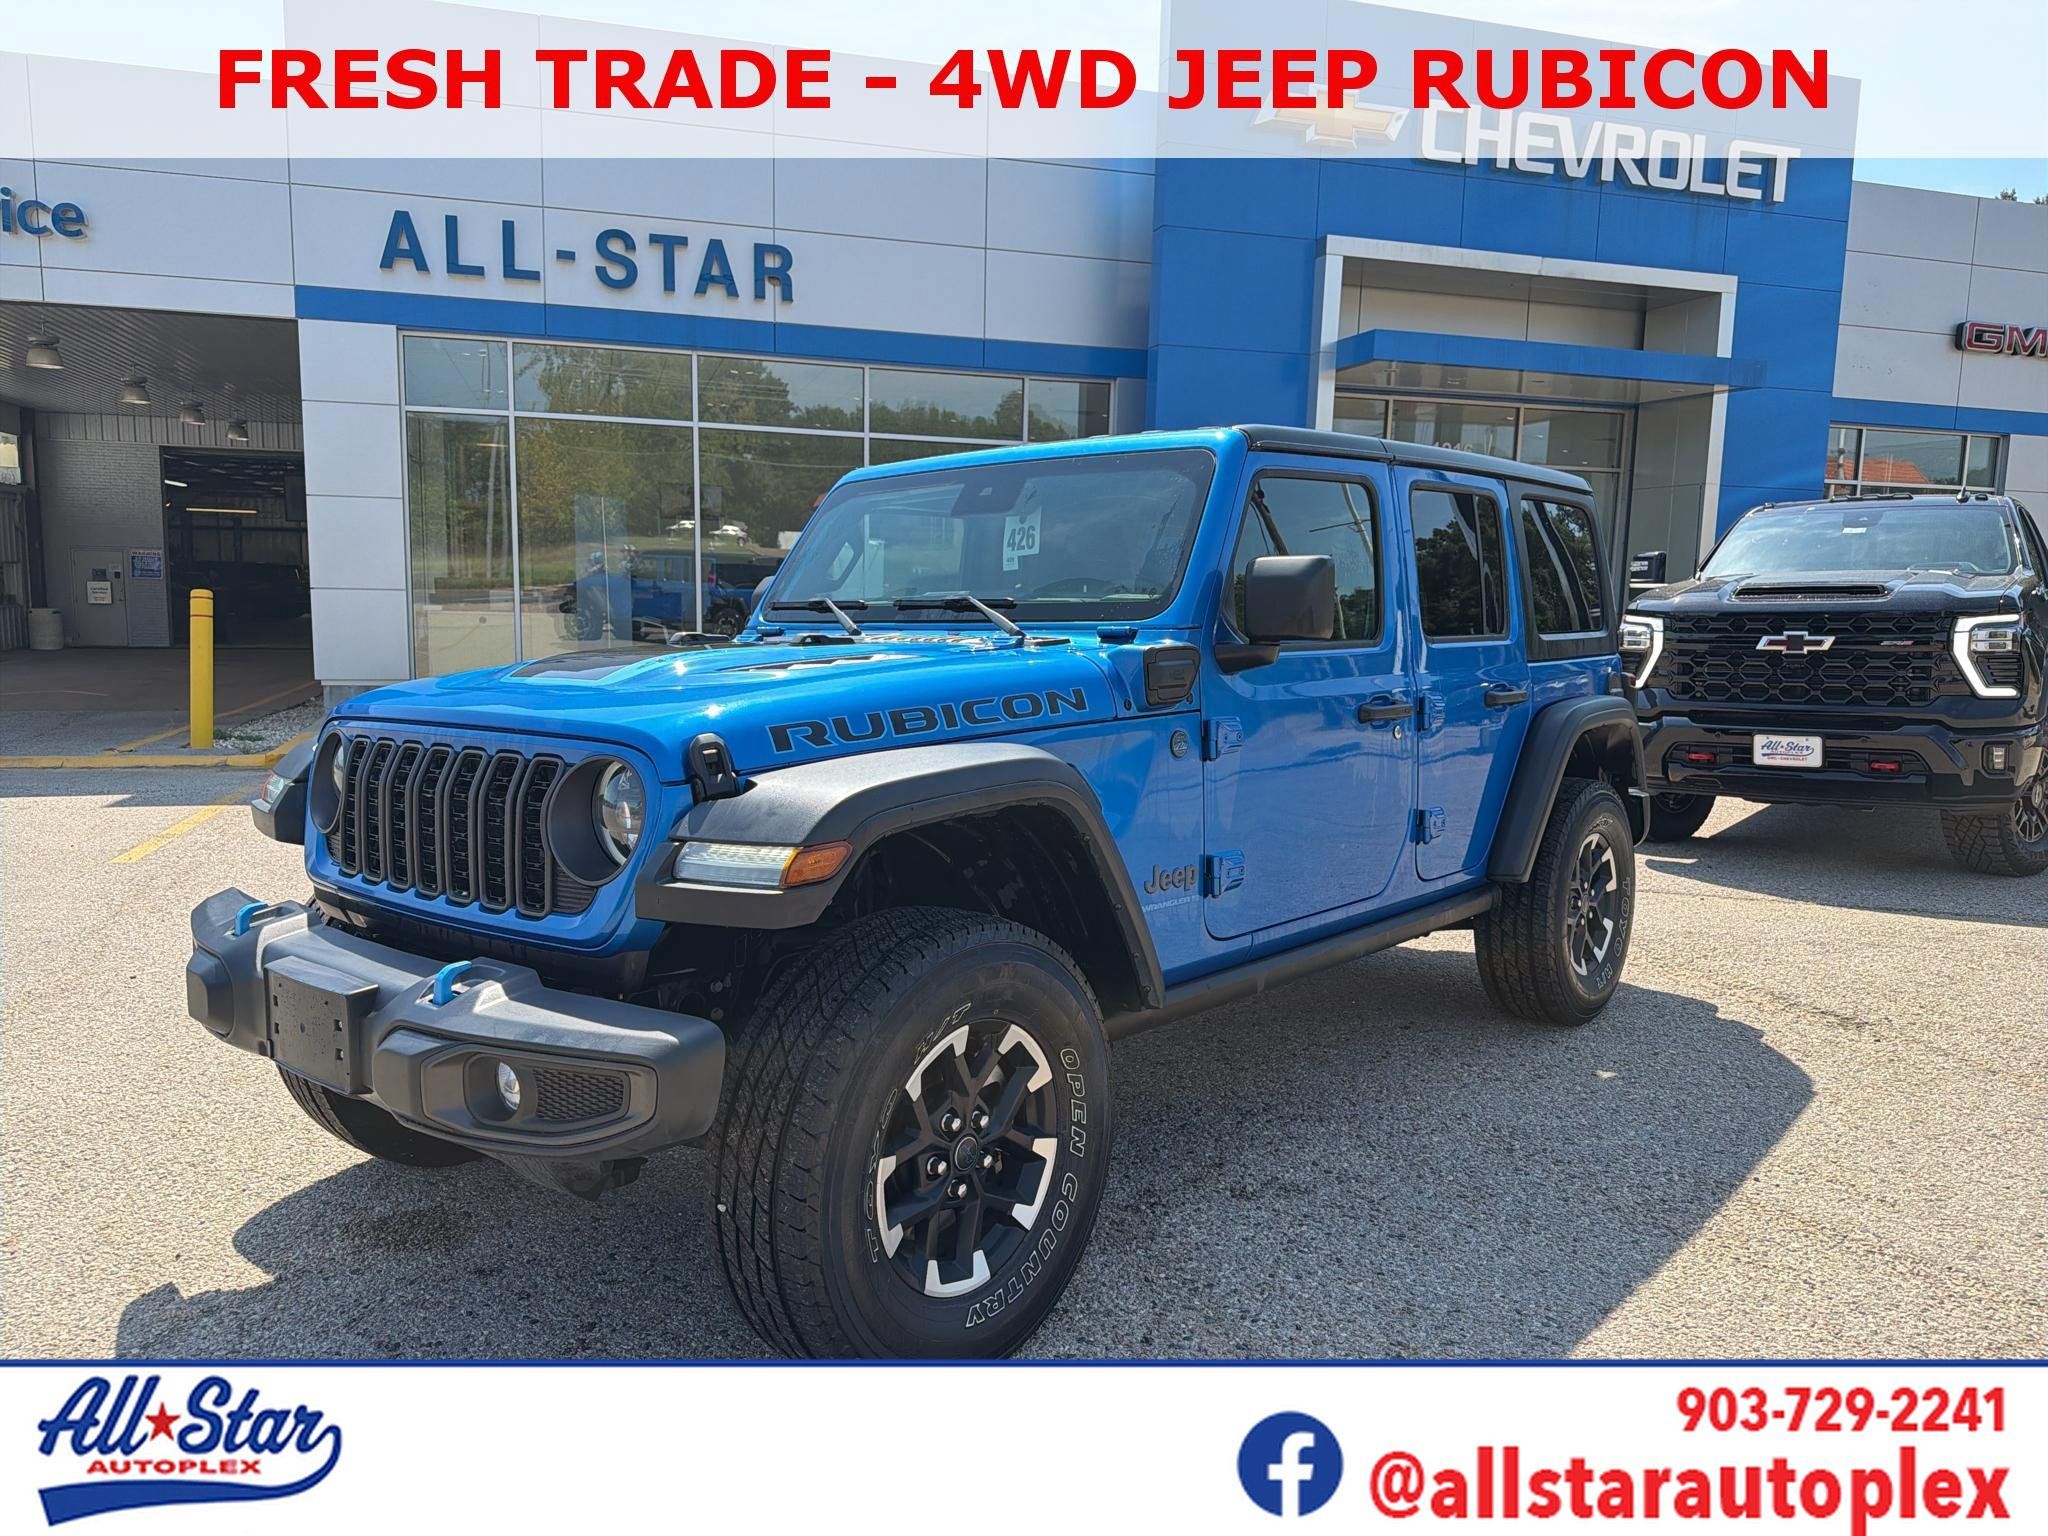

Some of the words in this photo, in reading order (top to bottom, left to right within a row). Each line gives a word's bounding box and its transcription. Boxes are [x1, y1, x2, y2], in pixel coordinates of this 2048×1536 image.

[1420, 98, 1801, 203] CHEVROLET
[379, 209, 795, 304] ALL-STAR
[1006, 525, 1036, 551] 426
[765, 687, 1090, 753] RUBICON
[1143, 863, 1199, 895] Jeep
[1060, 1047, 1088, 1158] OPEN
[965, 1172, 1079, 1329] COUNTRY
